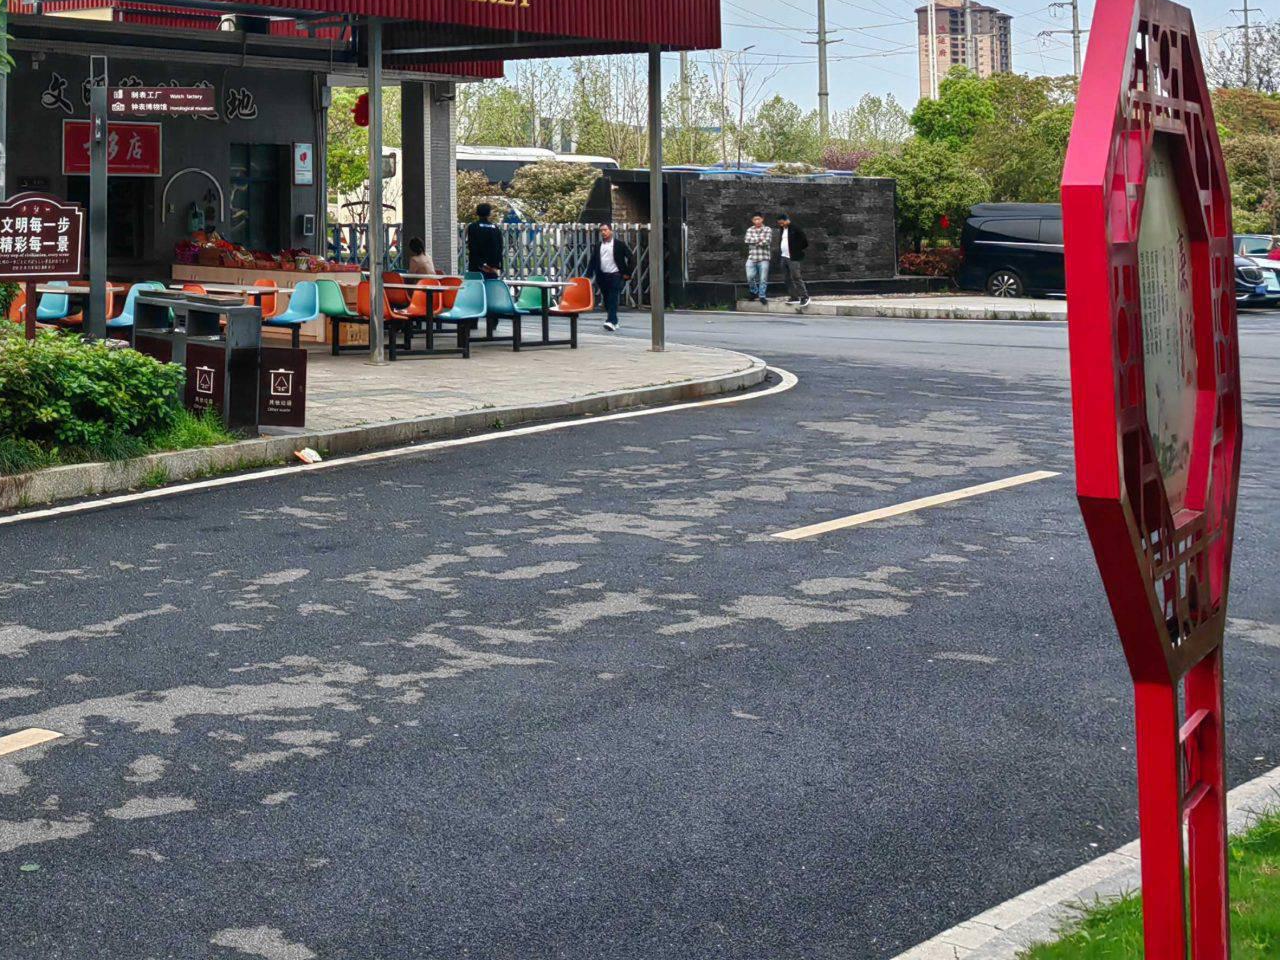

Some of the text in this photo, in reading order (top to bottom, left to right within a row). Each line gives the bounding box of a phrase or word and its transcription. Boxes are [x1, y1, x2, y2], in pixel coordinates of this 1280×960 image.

[130, 91, 162, 99] 制表工厂
[130, 103, 168, 111] 钟表博物馆
[0, 216, 70, 233] 文明每一步
[0, 235, 69, 253] 精彩每一景
